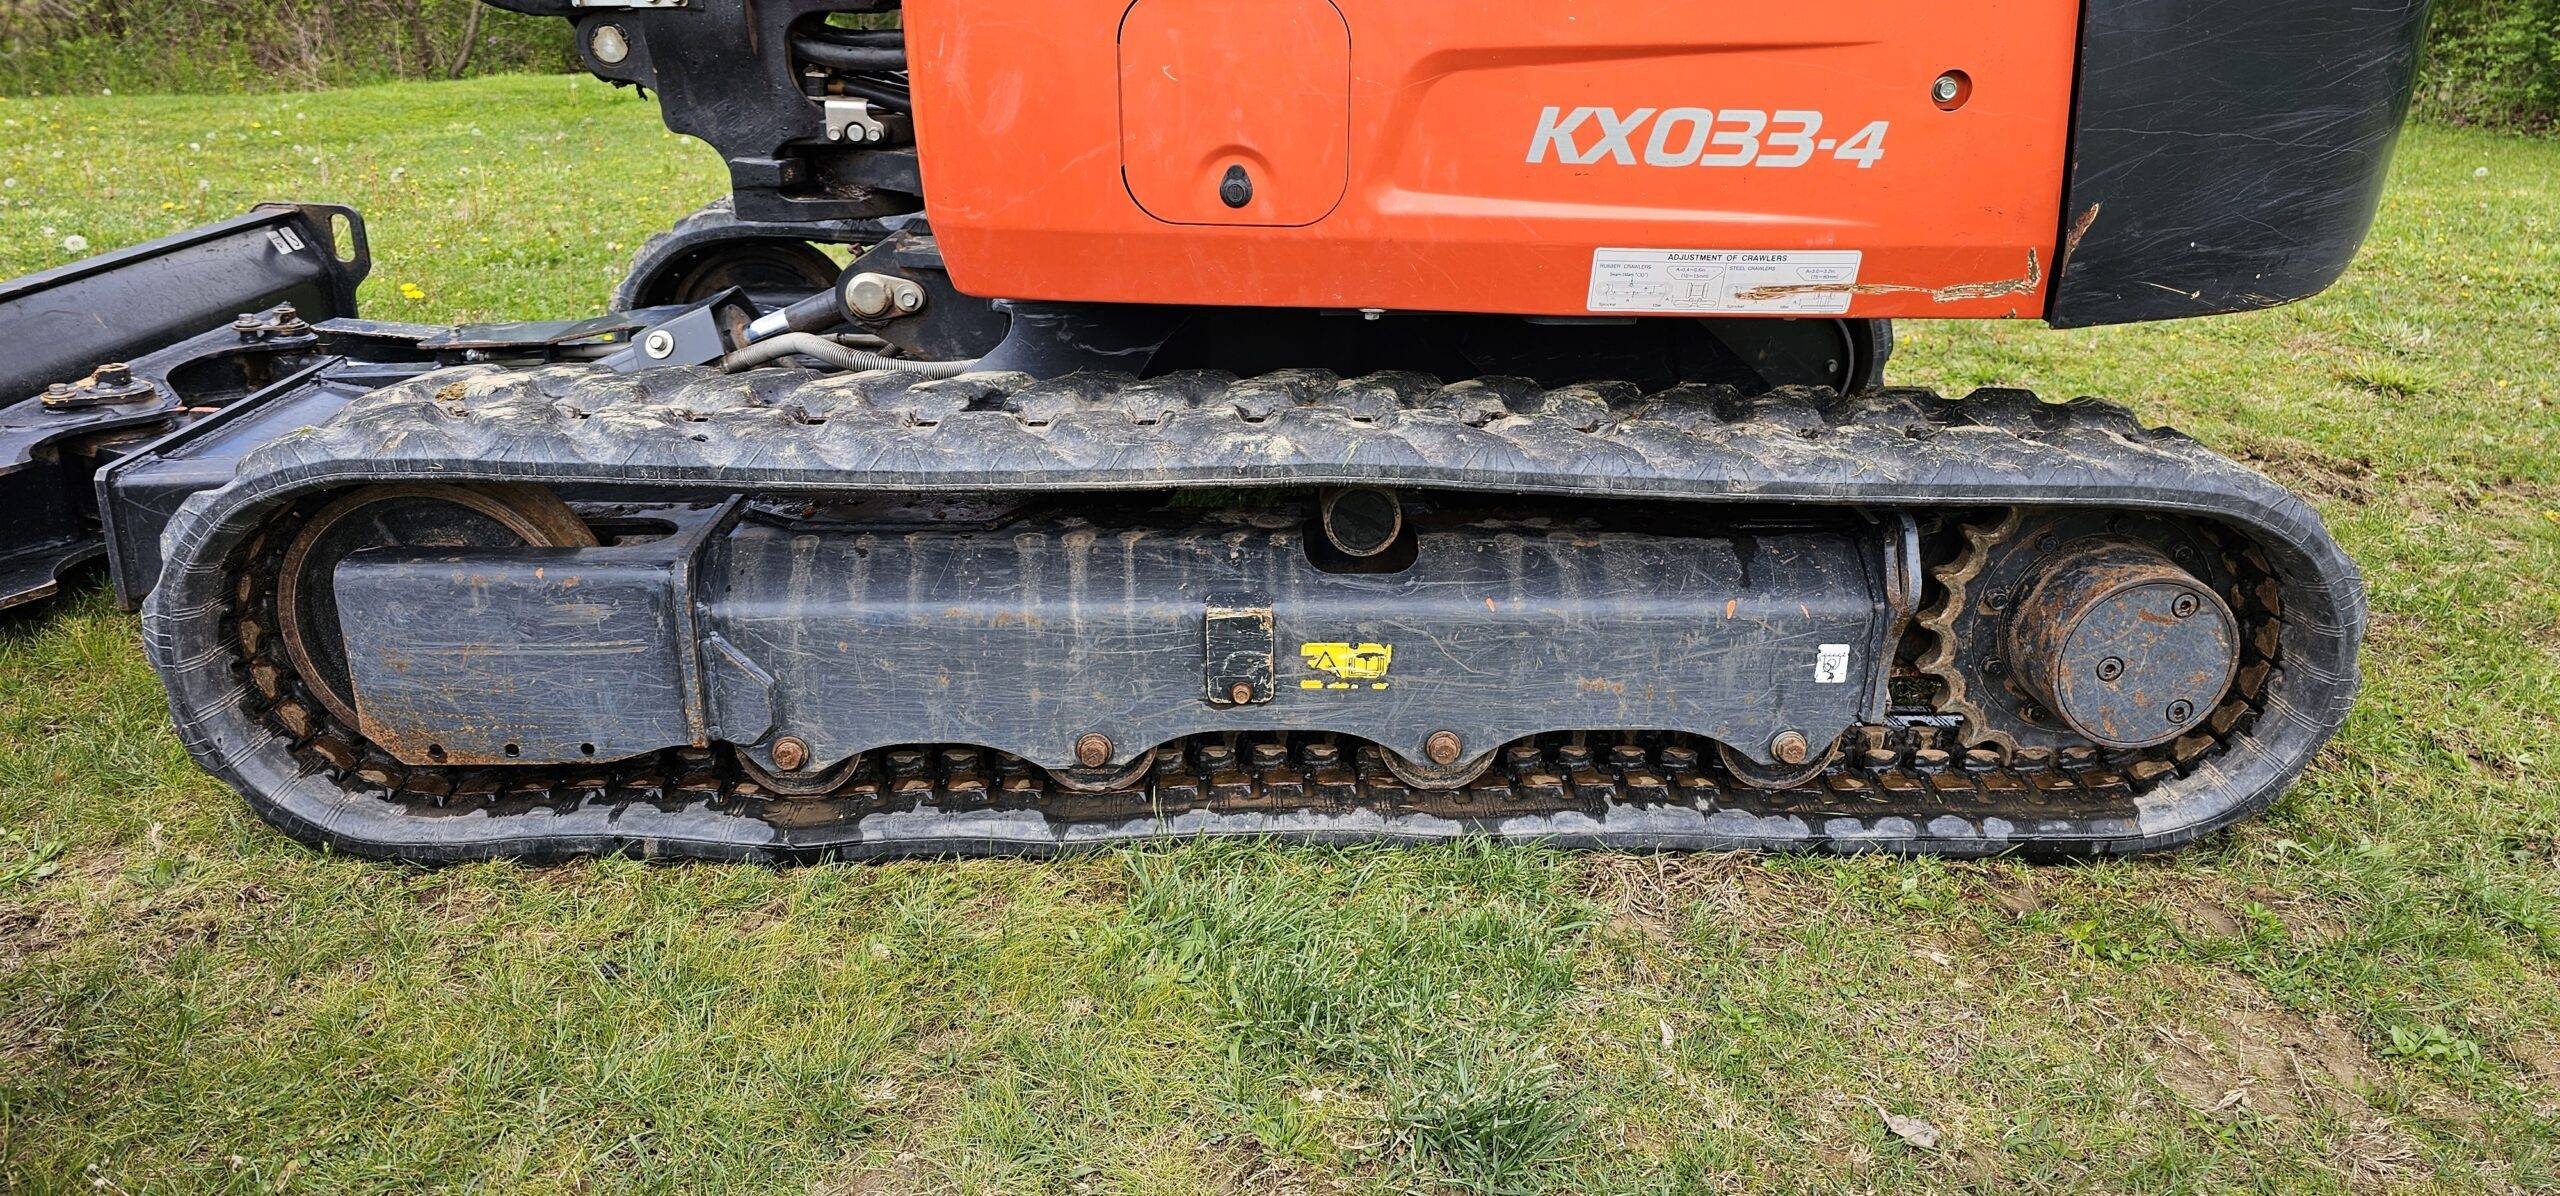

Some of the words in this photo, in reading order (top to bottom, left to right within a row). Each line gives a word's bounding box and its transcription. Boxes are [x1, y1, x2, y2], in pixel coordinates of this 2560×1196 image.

[1525, 106, 1889, 168] KX033-4
[1667, 253, 1723, 262] ADJUSTMENT
[1726, 254, 1739, 262] OF
[1741, 254, 1788, 262] CRAWLERS
